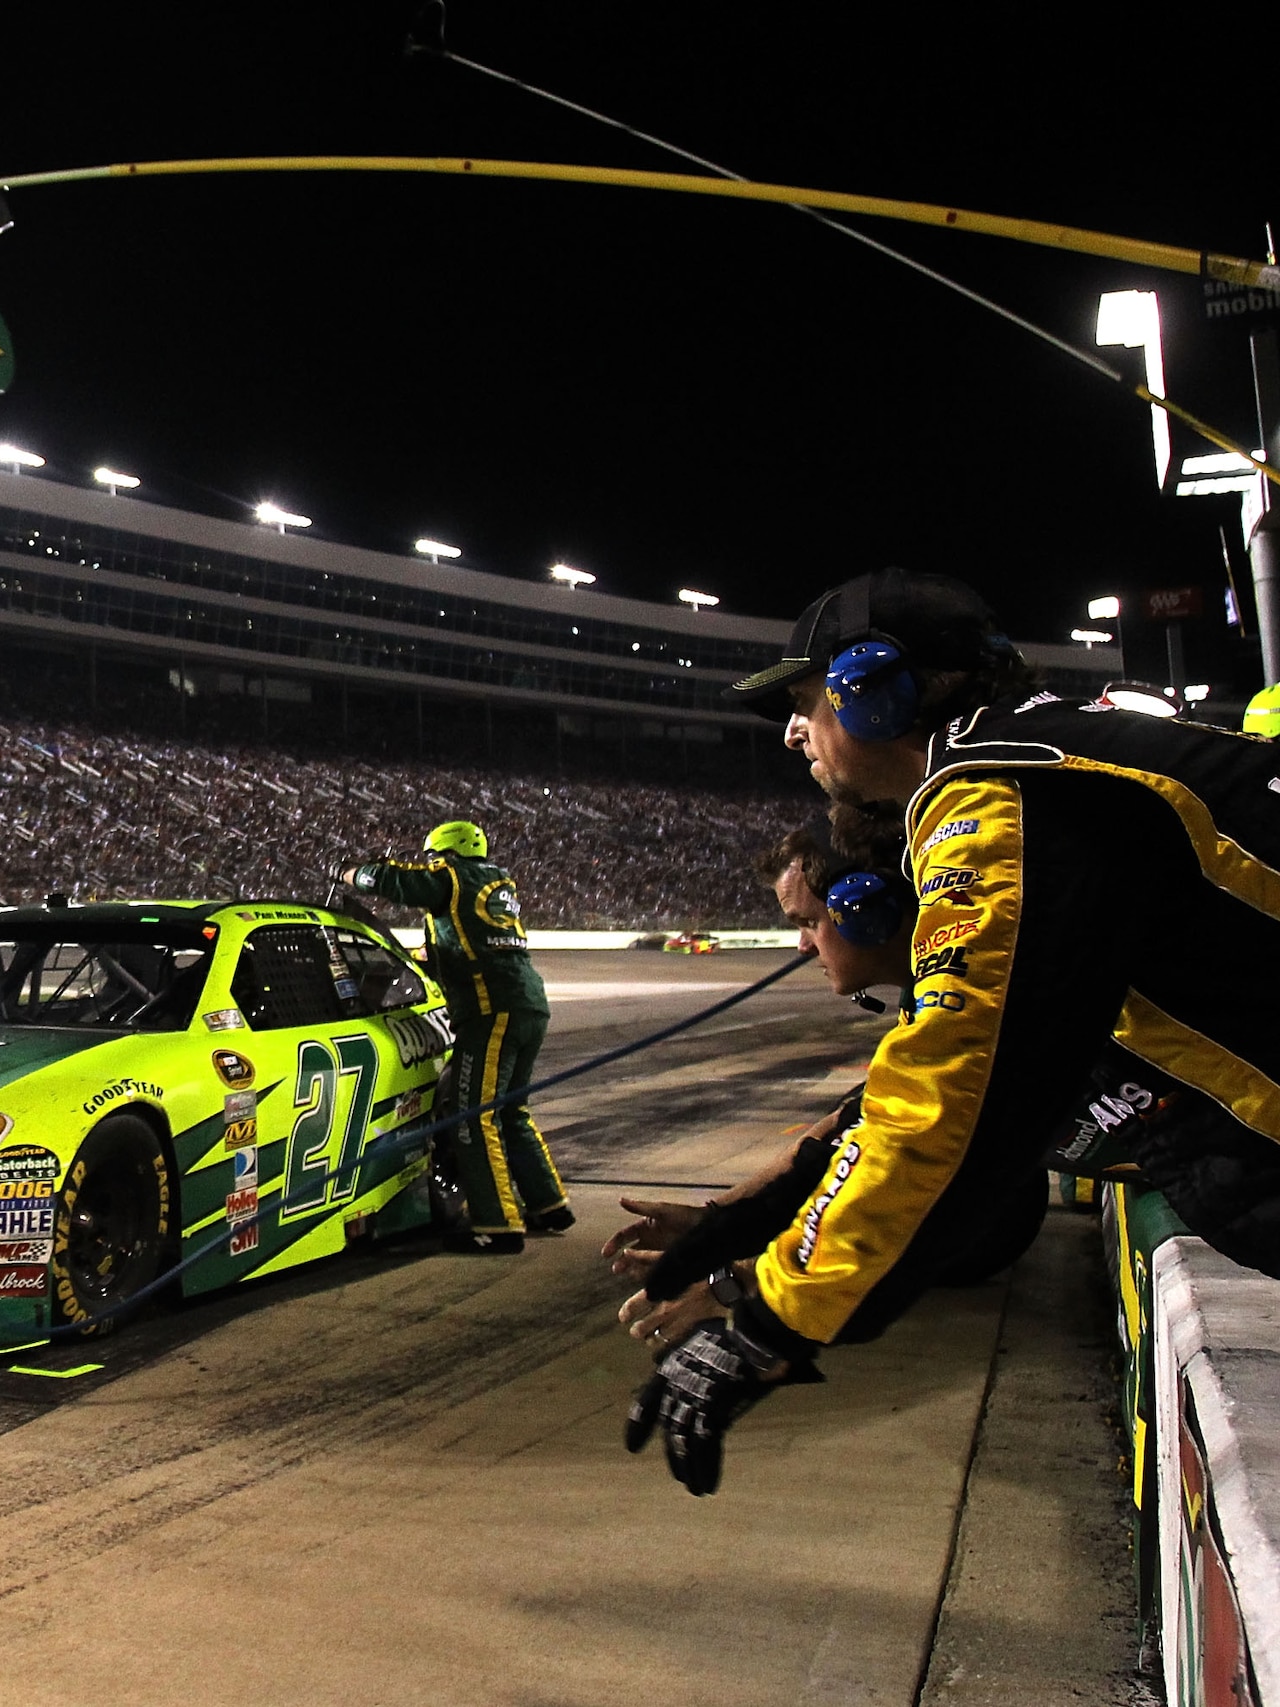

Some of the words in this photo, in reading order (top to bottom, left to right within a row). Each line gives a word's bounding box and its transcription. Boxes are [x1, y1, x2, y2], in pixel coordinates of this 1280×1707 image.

[83, 1079, 164, 1115] GOODYEAR
[282, 1033, 379, 1217] 27
[0, 1170, 56, 1179] BELTS
[152, 1153, 170, 1235] EAGLE
